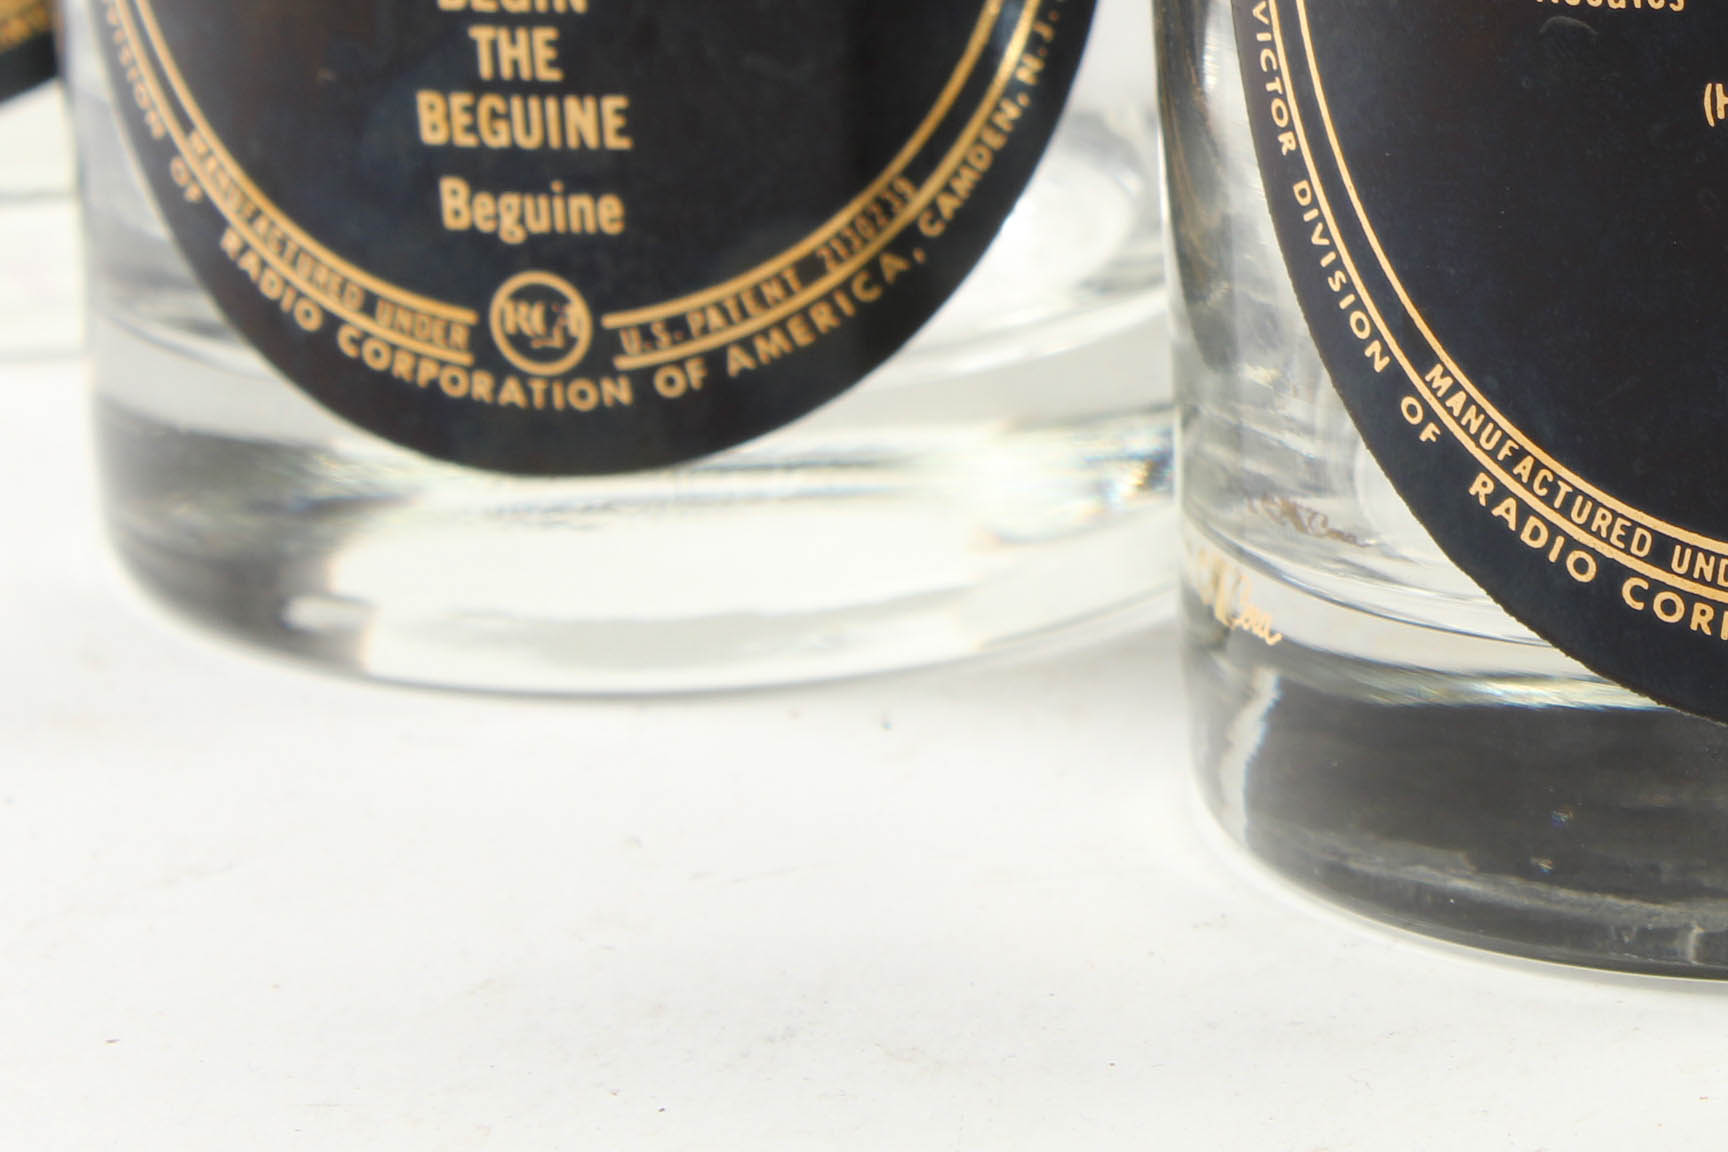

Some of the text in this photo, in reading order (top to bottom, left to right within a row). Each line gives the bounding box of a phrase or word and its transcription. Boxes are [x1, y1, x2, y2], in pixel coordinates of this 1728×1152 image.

[468, 25, 564, 82] THE
[416, 90, 634, 150] BEGUINE
[189, 128, 471, 350] MANUFACTURED UNDER
[439, 175, 625, 245] Beguine
[220, 227, 324, 332] RADIO
[336, 324, 634, 412] CORPORATION
[653, 357, 708, 398] OF
[686, 266, 803, 338] PATENT
[1252, 0, 1299, 158] VICTOR
[1292, 179, 1391, 374] DIVISION
[1400, 395, 1442, 444] OF
[1468, 471, 1598, 583] RADIO
[1424, 363, 1654, 559] MANUFACTURED
